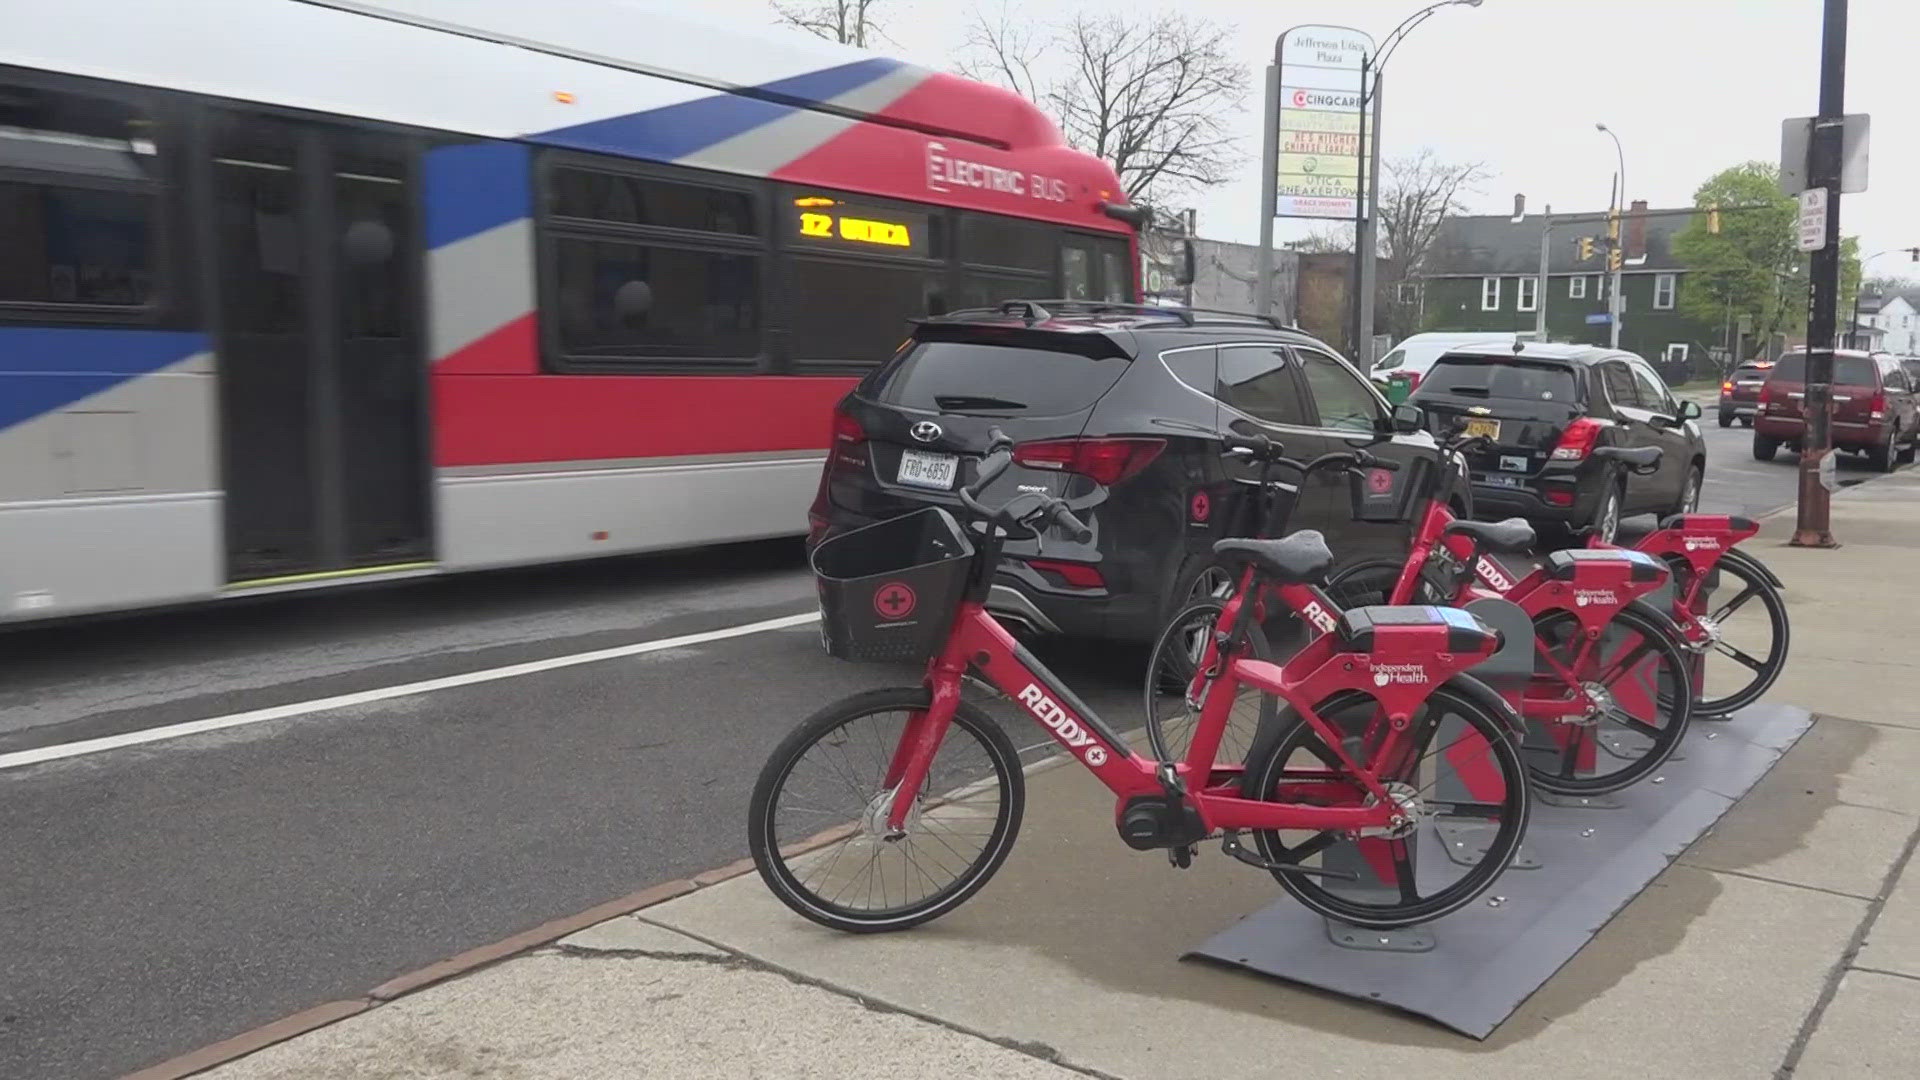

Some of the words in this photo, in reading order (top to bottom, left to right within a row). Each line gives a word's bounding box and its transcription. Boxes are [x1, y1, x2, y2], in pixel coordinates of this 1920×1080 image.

[1294, 37, 1338, 50] Jefferson
[1316, 51, 1342, 62] Plaza
[1306, 95, 1361, 108] CINQCARE
[926, 141, 1025, 195] ELECTRIC
[1030, 174, 1066, 202] BUS
[1306, 175, 1342, 186] UTICA
[1476, 556, 1514, 591] EDDY
[1370, 663, 1423, 674] Independent
[1390, 671, 1428, 684] Health
[1018, 683, 1097, 747] REDDY
